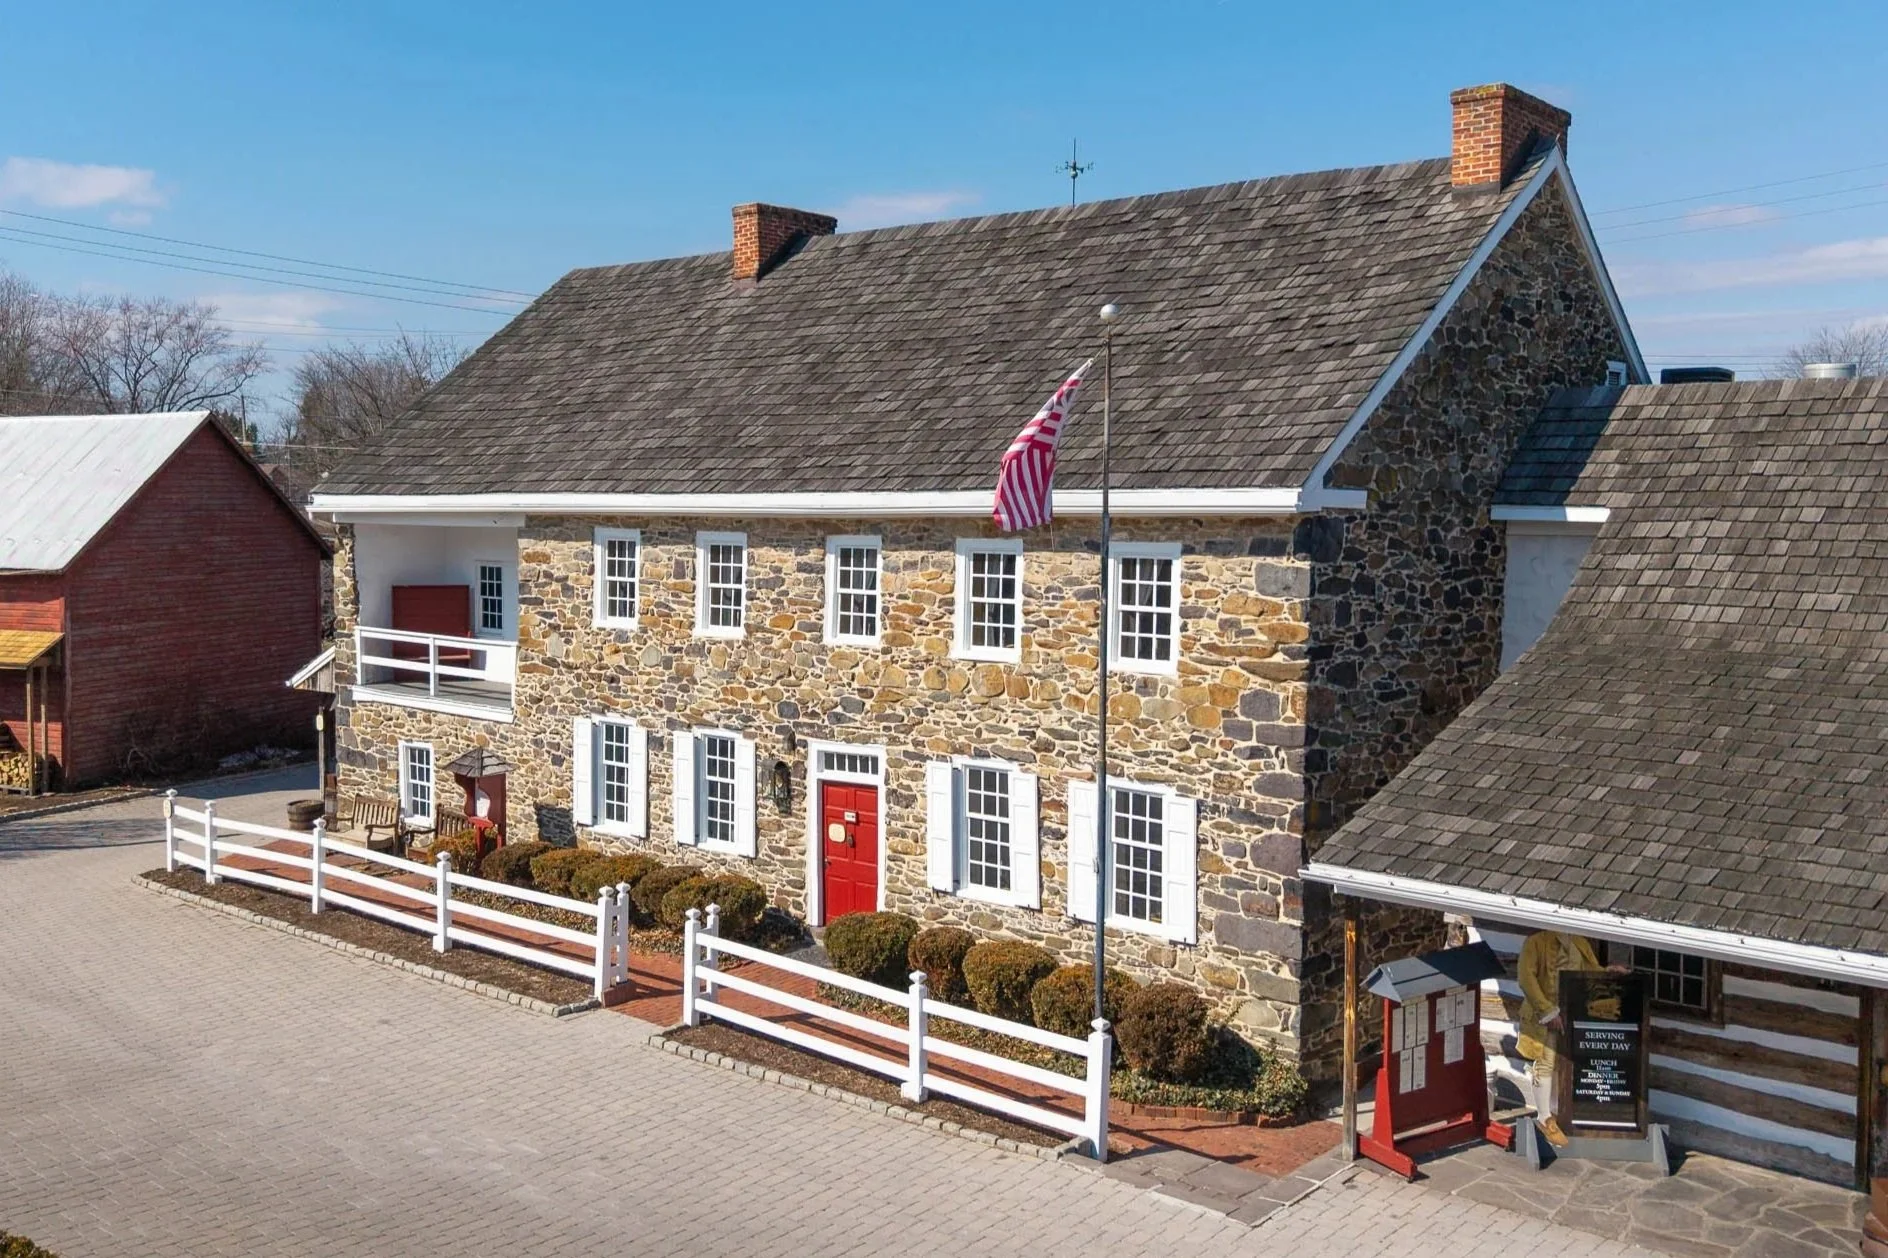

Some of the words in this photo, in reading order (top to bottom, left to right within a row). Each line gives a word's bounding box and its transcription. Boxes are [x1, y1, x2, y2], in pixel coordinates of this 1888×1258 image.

[1585, 1032, 1624, 1040] SERVING
[1580, 1042, 1608, 1050] EVERY
[1612, 1042, 1630, 1050] DAY
